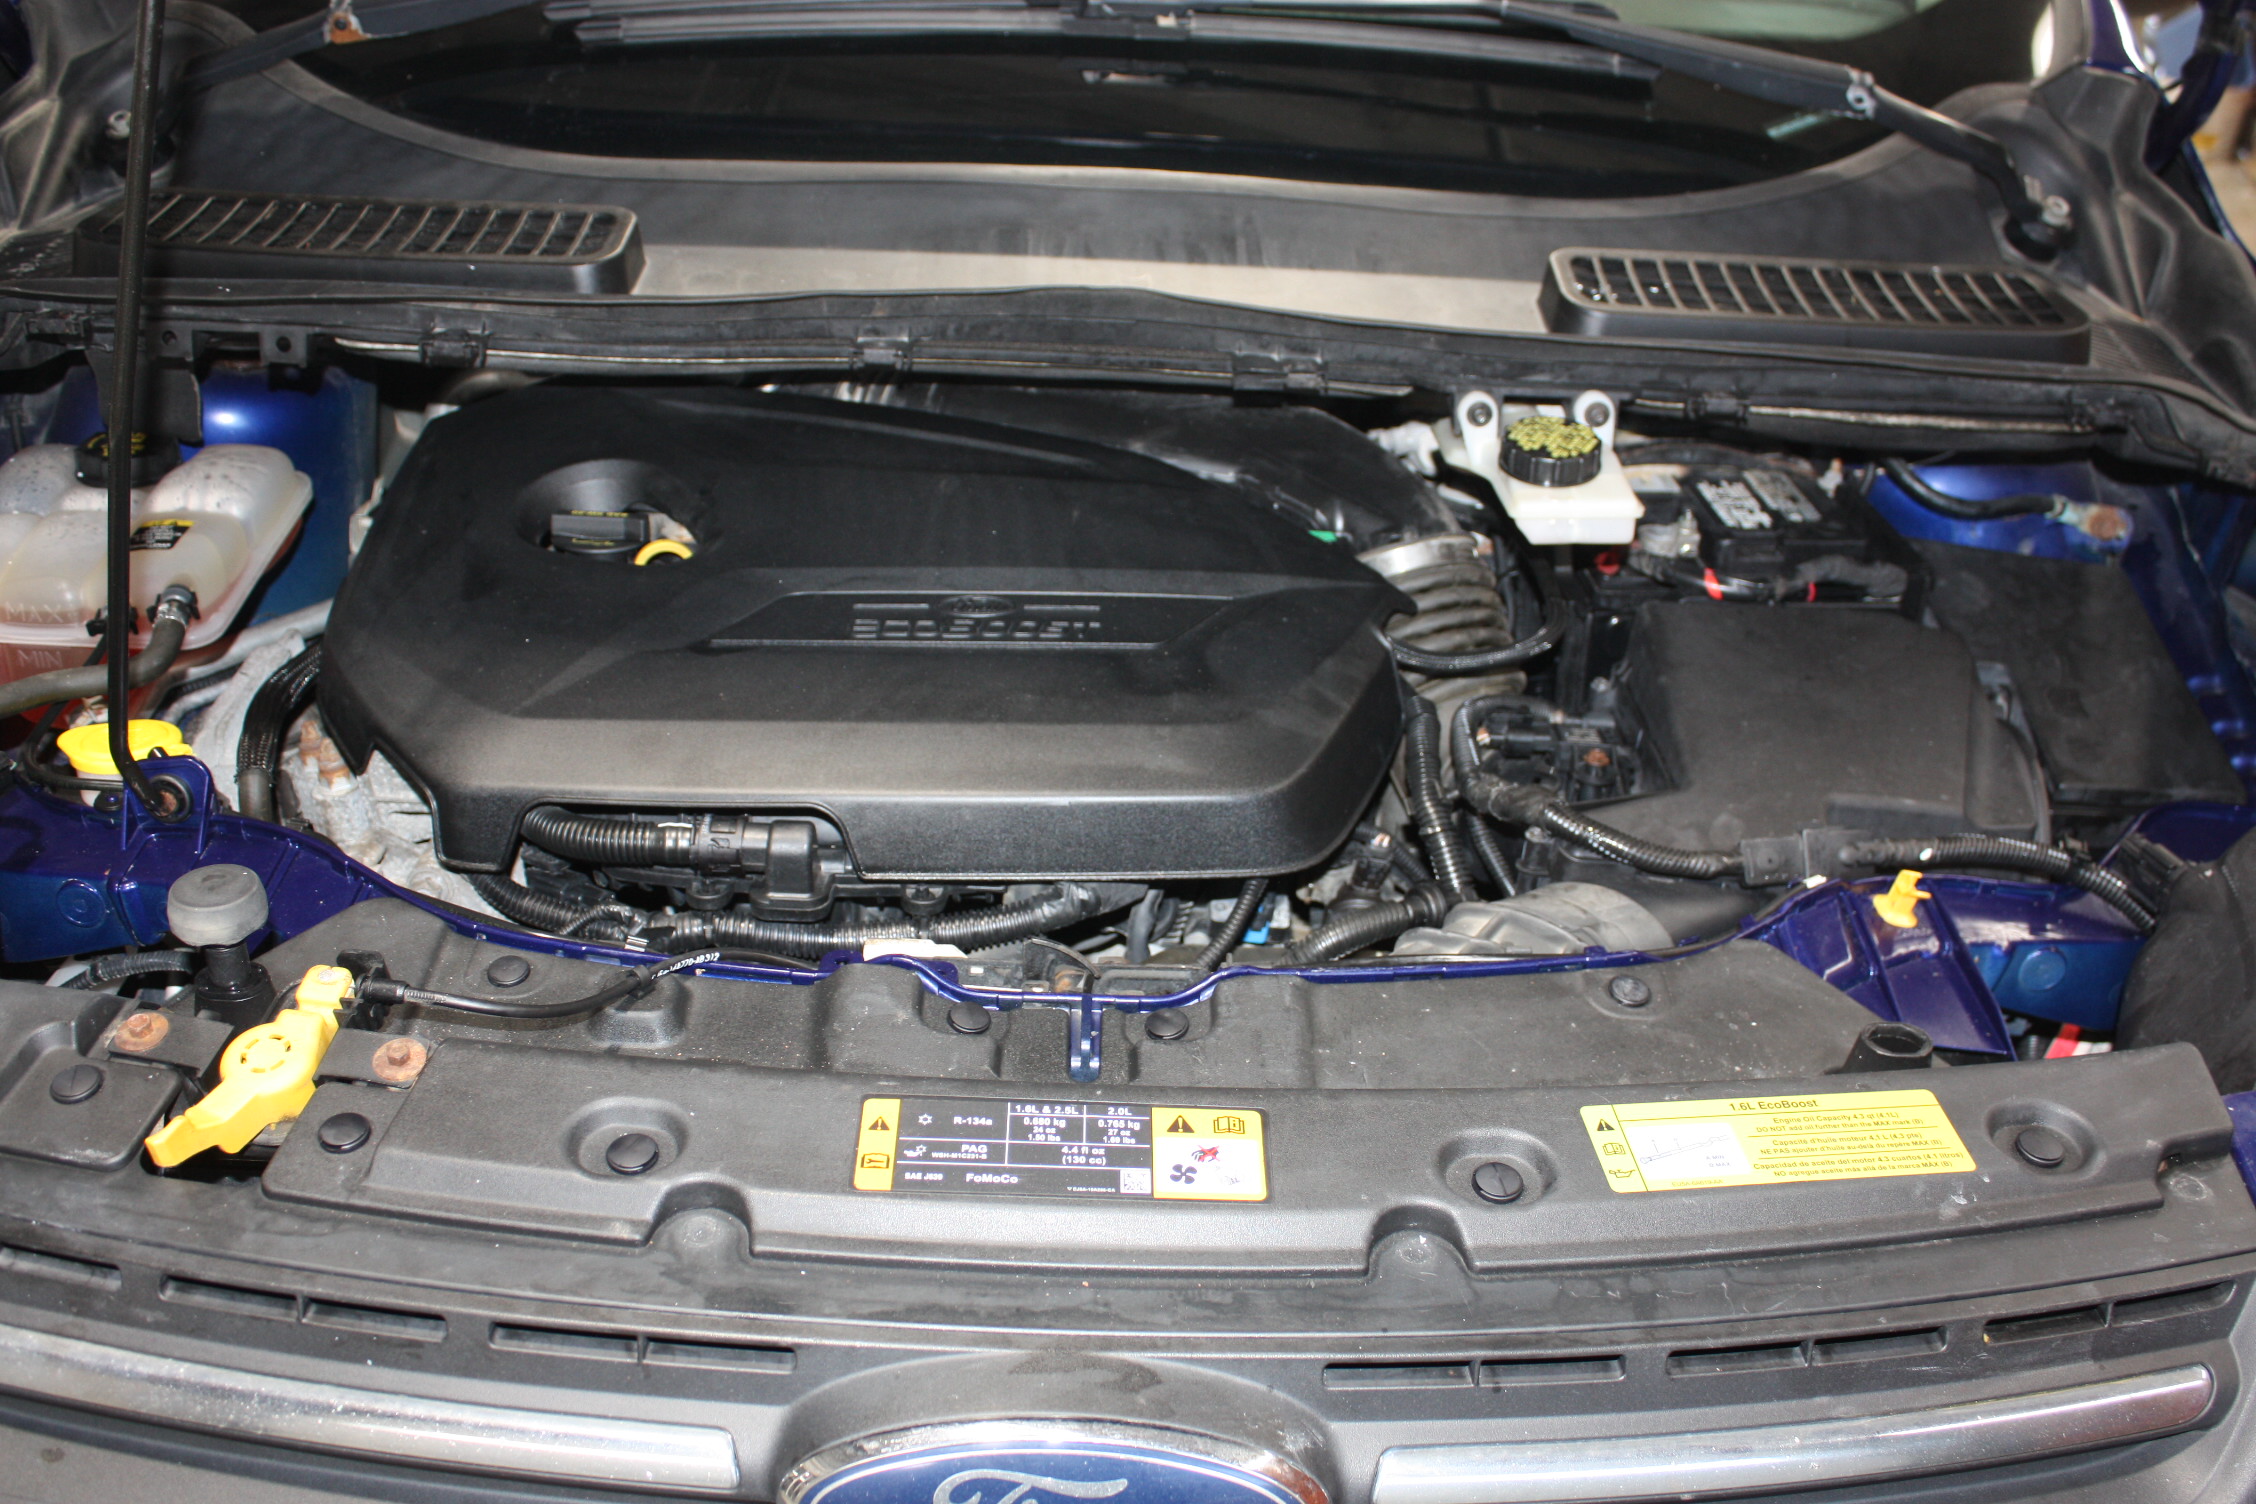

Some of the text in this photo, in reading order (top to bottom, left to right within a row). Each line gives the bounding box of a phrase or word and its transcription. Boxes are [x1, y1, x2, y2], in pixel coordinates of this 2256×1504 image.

[5, 601, 64, 622] MAX
[17, 648, 64, 669] MIN
[1042, 1105, 1051, 1114] &
[1728, 1099, 1819, 1113] 1.6L EcoBoost
[1107, 1107, 1132, 1116] 2.0L
[953, 1116, 993, 1126] R-134a
[1053, 1118, 1066, 1128] kg
[1772, 1116, 1801, 1124] Engine
[1802, 1115, 1815, 1123] Oil
[1816, 1113, 1851, 1122] Capacity
[1098, 1119, 1141, 1130] 0.765 kg
[1107, 1128, 1118, 1136] 27
[1047, 1134, 1061, 1142] lbs
[1102, 1136, 1136, 1144] 1.69 lbs
[961, 1144, 988, 1154] PAG
[1061, 1146, 1079, 1155] 4.4
[1080, 1146, 1089, 1155] fl
[1061, 1155, 1107, 1166] (130 cc)
[1753, 1160, 1798, 1170] Capacidad
[1811, 1159, 1836, 1167] aceite
[1891, 1154, 1922, 1162] cuartos
[904, 1172, 922, 1180] SAE
[966, 1173, 1019, 1184] FoMoCo
